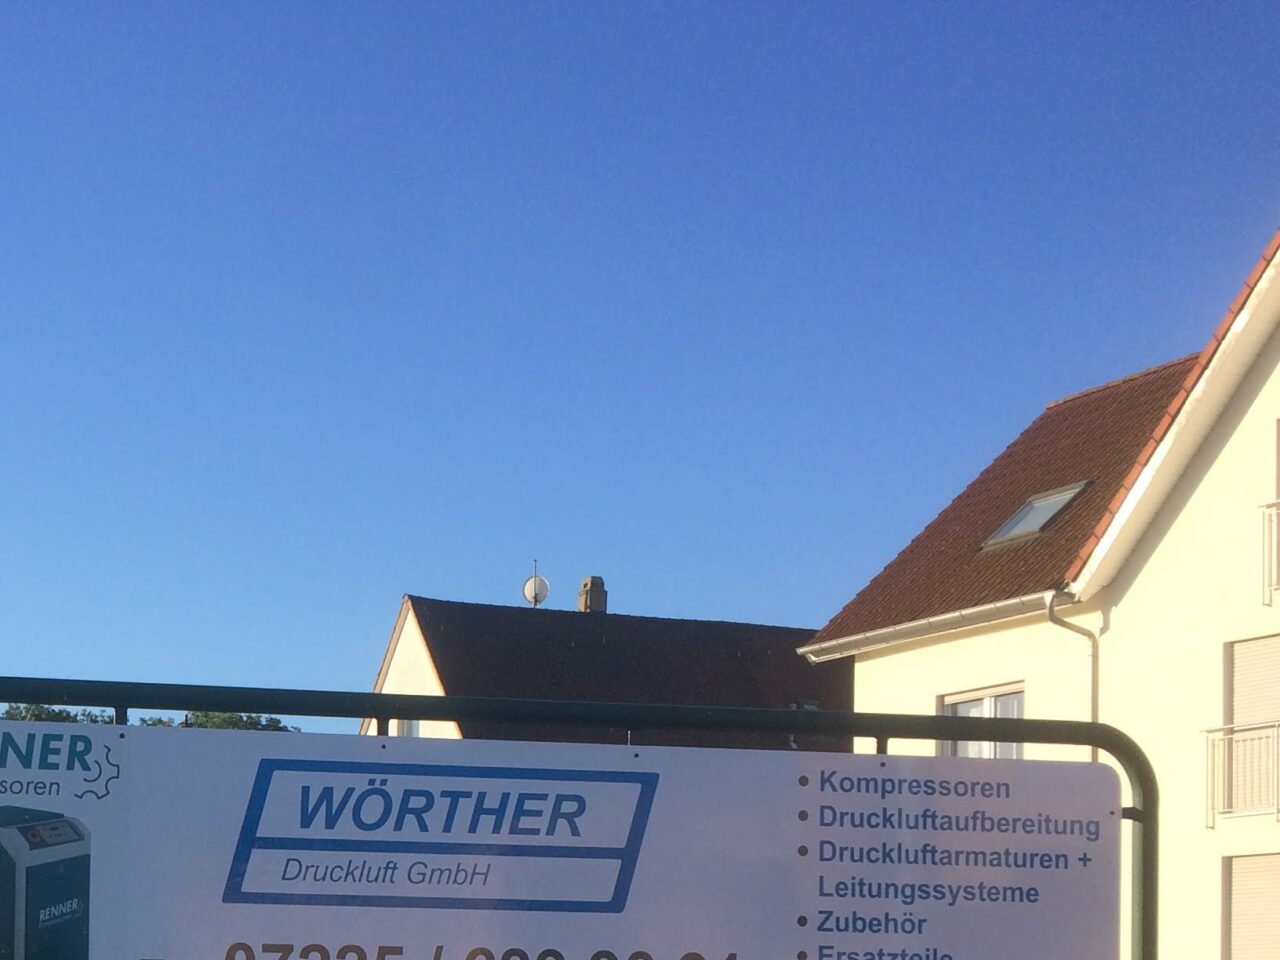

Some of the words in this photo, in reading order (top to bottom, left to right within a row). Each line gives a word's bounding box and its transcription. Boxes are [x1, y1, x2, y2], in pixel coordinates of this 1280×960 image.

[819, 770, 1011, 799] Kompressoren
[299, 778, 588, 837] WÖRTHER
[819, 805, 1101, 842] Druckluftaufbereitung
[819, 840, 1069, 870] Druckluftarmaturen
[1078, 852, 1093, 868] +
[281, 857, 398, 885] Druckluft
[408, 862, 491, 887] GmbH
[818, 876, 1040, 906] Leitungssysteme
[40, 898, 78, 921] RENNER
[817, 910, 928, 935] Zubehör
